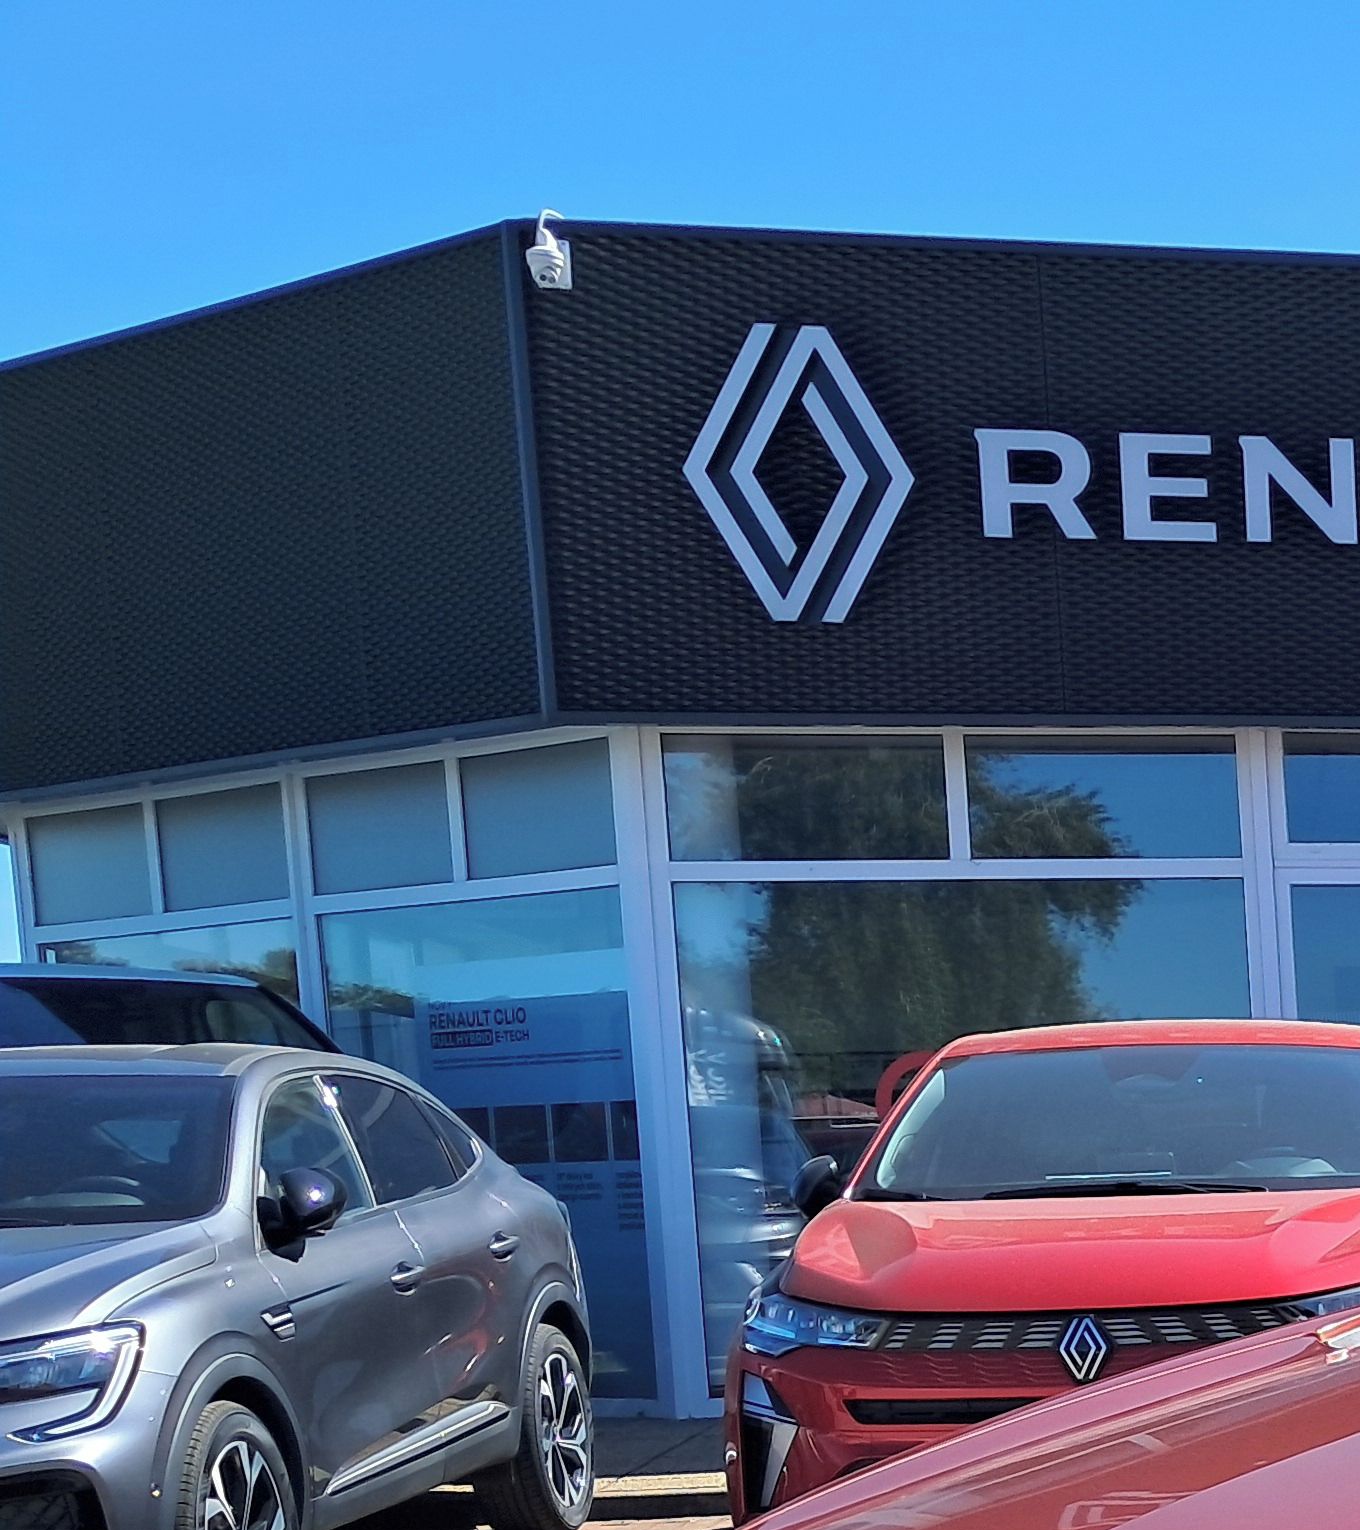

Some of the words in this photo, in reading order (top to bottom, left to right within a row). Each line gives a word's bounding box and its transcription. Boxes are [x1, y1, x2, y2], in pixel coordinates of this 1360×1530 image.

[429, 1010, 491, 1030] RENAULT
[493, 1007, 527, 1026] CLIO
[494, 1028, 530, 1043] E-TECH
